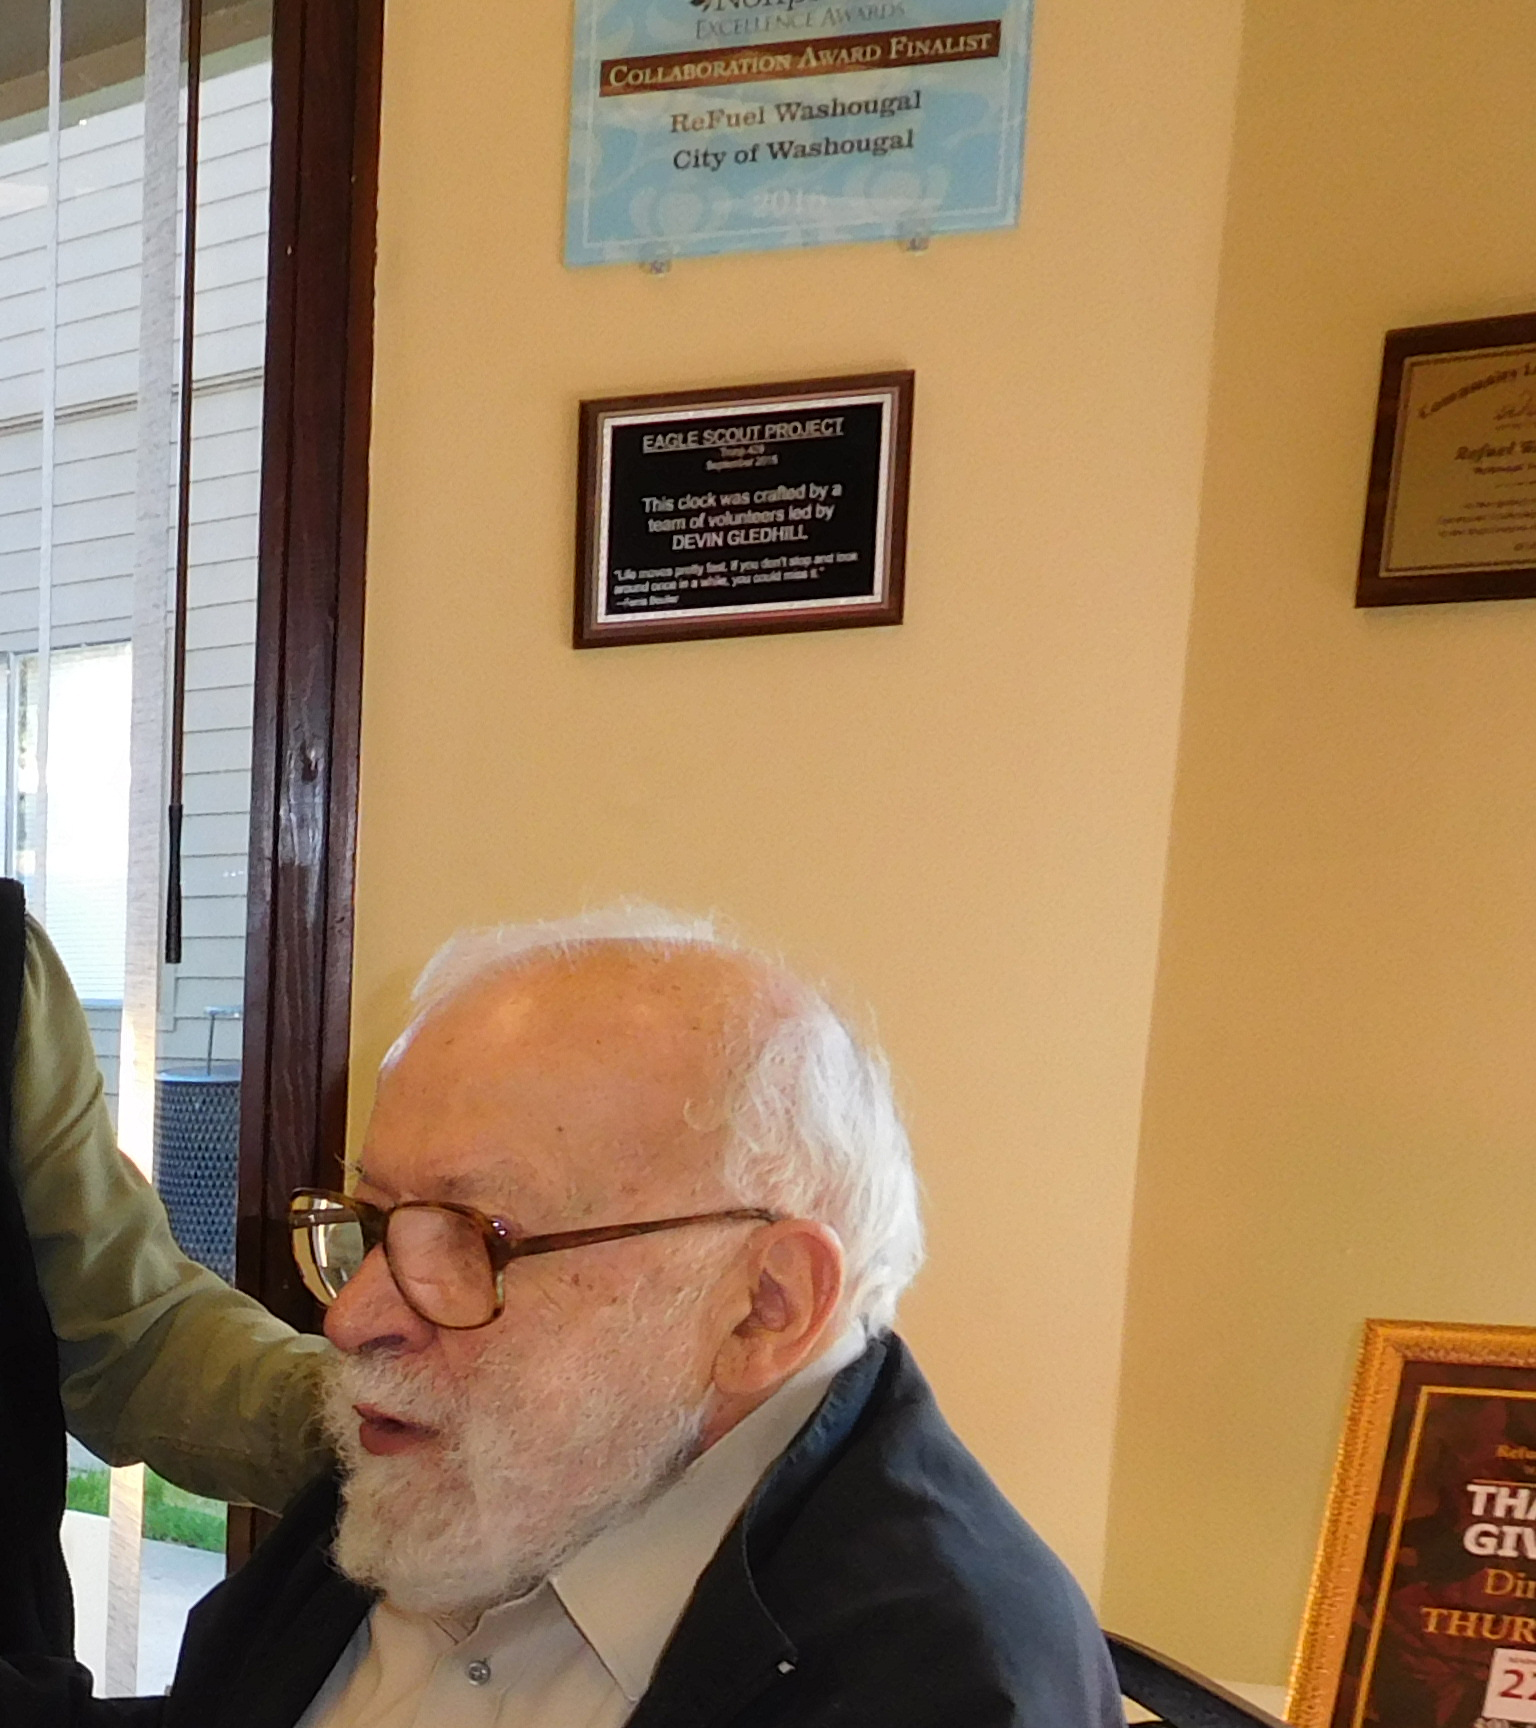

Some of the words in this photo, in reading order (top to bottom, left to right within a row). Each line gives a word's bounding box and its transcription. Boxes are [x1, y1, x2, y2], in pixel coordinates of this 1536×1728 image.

[609, 54, 793, 87] COLLABORATION
[796, 45, 882, 70] AWARD
[888, 33, 993, 59] FINALIST
[671, 106, 765, 133] ReFuel
[775, 90, 922, 123] Washougal
[673, 146, 726, 172] City
[734, 144, 760, 164] of
[767, 129, 914, 160] Washougal
[642, 431, 699, 449] EAGLE
[703, 425, 762, 445] SCOUT
[764, 417, 844, 440] PROJECT
[642, 496, 674, 513] This
[678, 492, 716, 510] clock
[720, 492, 750, 506] was
[753, 484, 806, 504] crafted
[809, 483, 829, 500] by
[832, 484, 842, 497] a
[648, 518, 686, 532] team
[689, 513, 706, 529] of
[709, 508, 785, 527] volunteers
[788, 504, 812, 520] led
[815, 503, 835, 521] by
[672, 532, 723, 550] DEVIN
[727, 525, 809, 545] GLEDHILL
